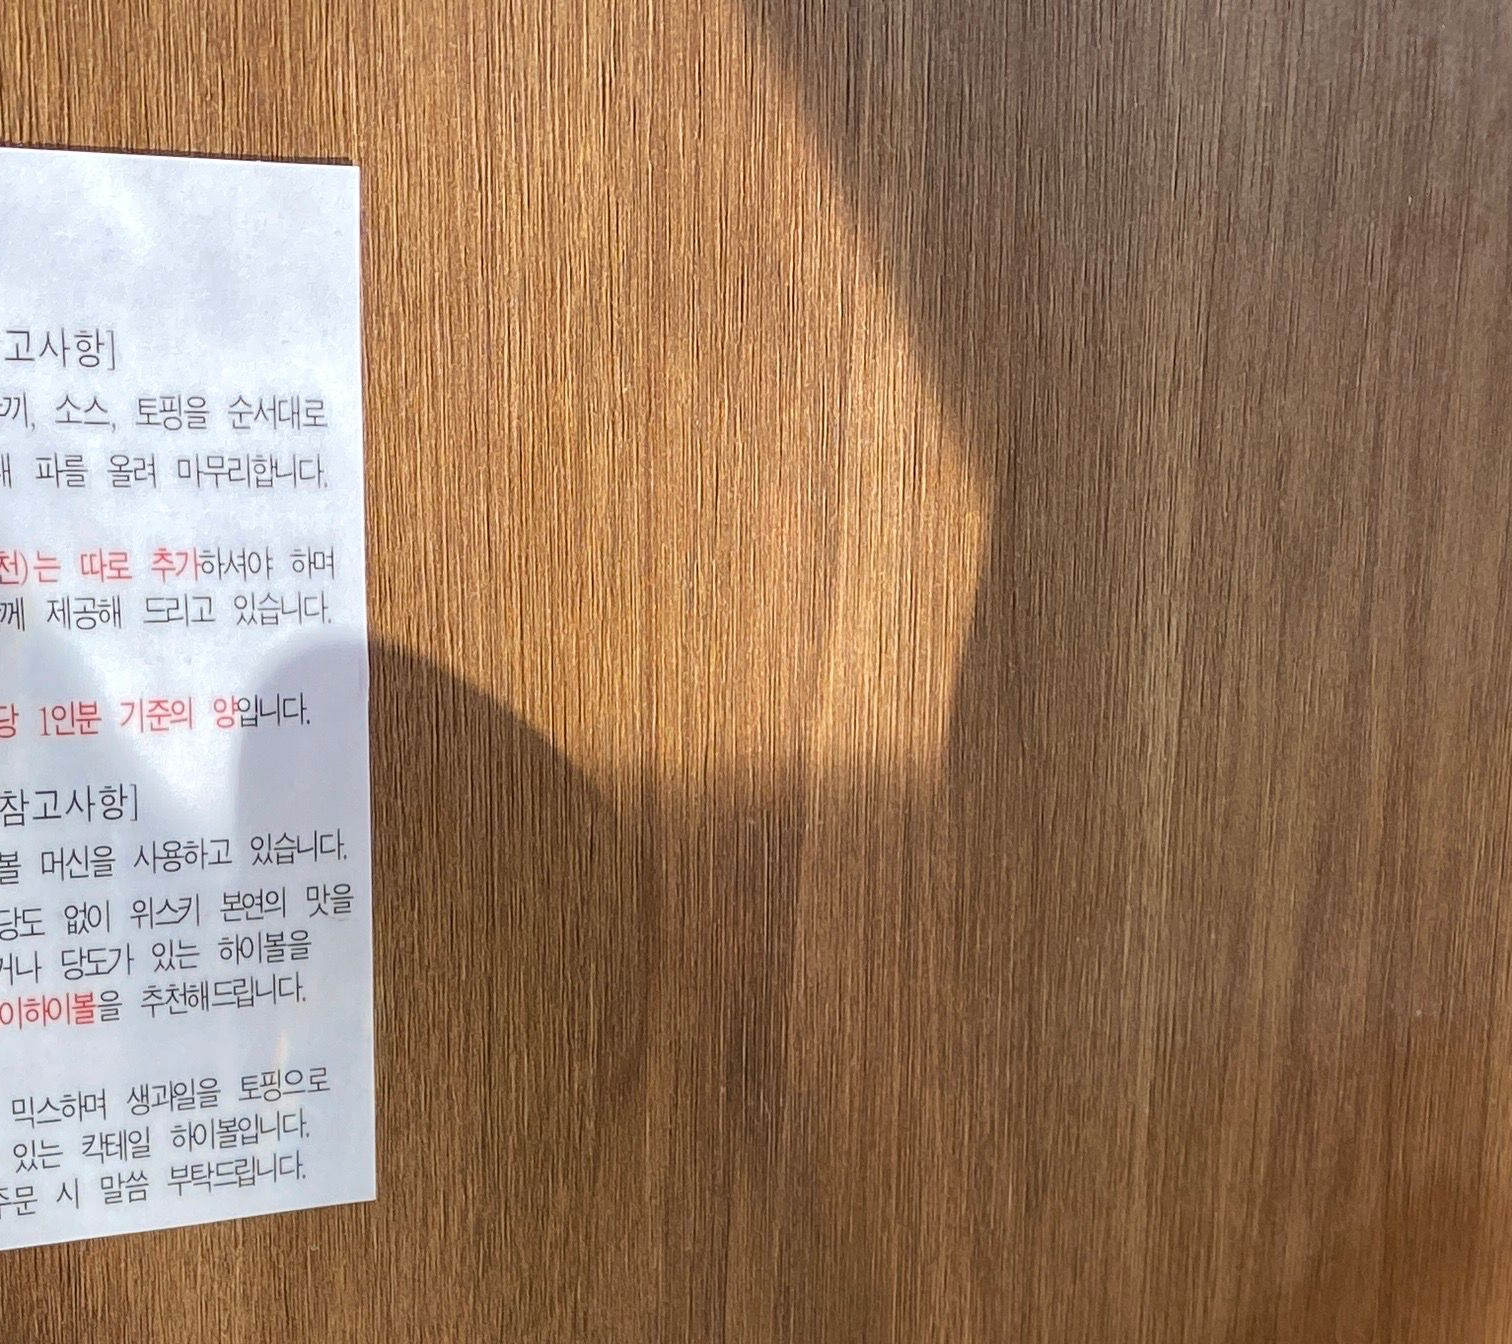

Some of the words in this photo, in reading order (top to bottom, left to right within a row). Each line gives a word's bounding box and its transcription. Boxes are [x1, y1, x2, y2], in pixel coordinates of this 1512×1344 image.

[55, 394, 115, 432] 소스,
[136, 395, 209, 430] 토핑을
[228, 395, 327, 430] 순서대로
[36, 452, 88, 487] 파를
[107, 453, 156, 488] 올려
[177, 454, 327, 488] 마무리합니다.
[81, 549, 132, 581] 따로
[151, 547, 273, 581] 추가하셔야
[290, 546, 334, 579] 하며
[47, 595, 121, 629] 제공해
[144, 594, 215, 627] 드리고
[234, 591, 330, 625] 있습니다.
[40, 701, 101, 735] 1인분
[121, 697, 192, 732] 기준의
[214, 692, 310, 728] 양입니다.
[0, 783, 137, 827] 참고사항]
[41, 845, 115, 881] 머신을
[133, 838, 232, 873] 사용하고
[250, 828, 346, 865] 있습니다.
[141, 971, 305, 1018] 추천해드립니다.
[12, 1088, 106, 1128] 믹스하며
[127, 1078, 221, 1115] 생과일을
[238, 1067, 330, 1101] 토핑으로
